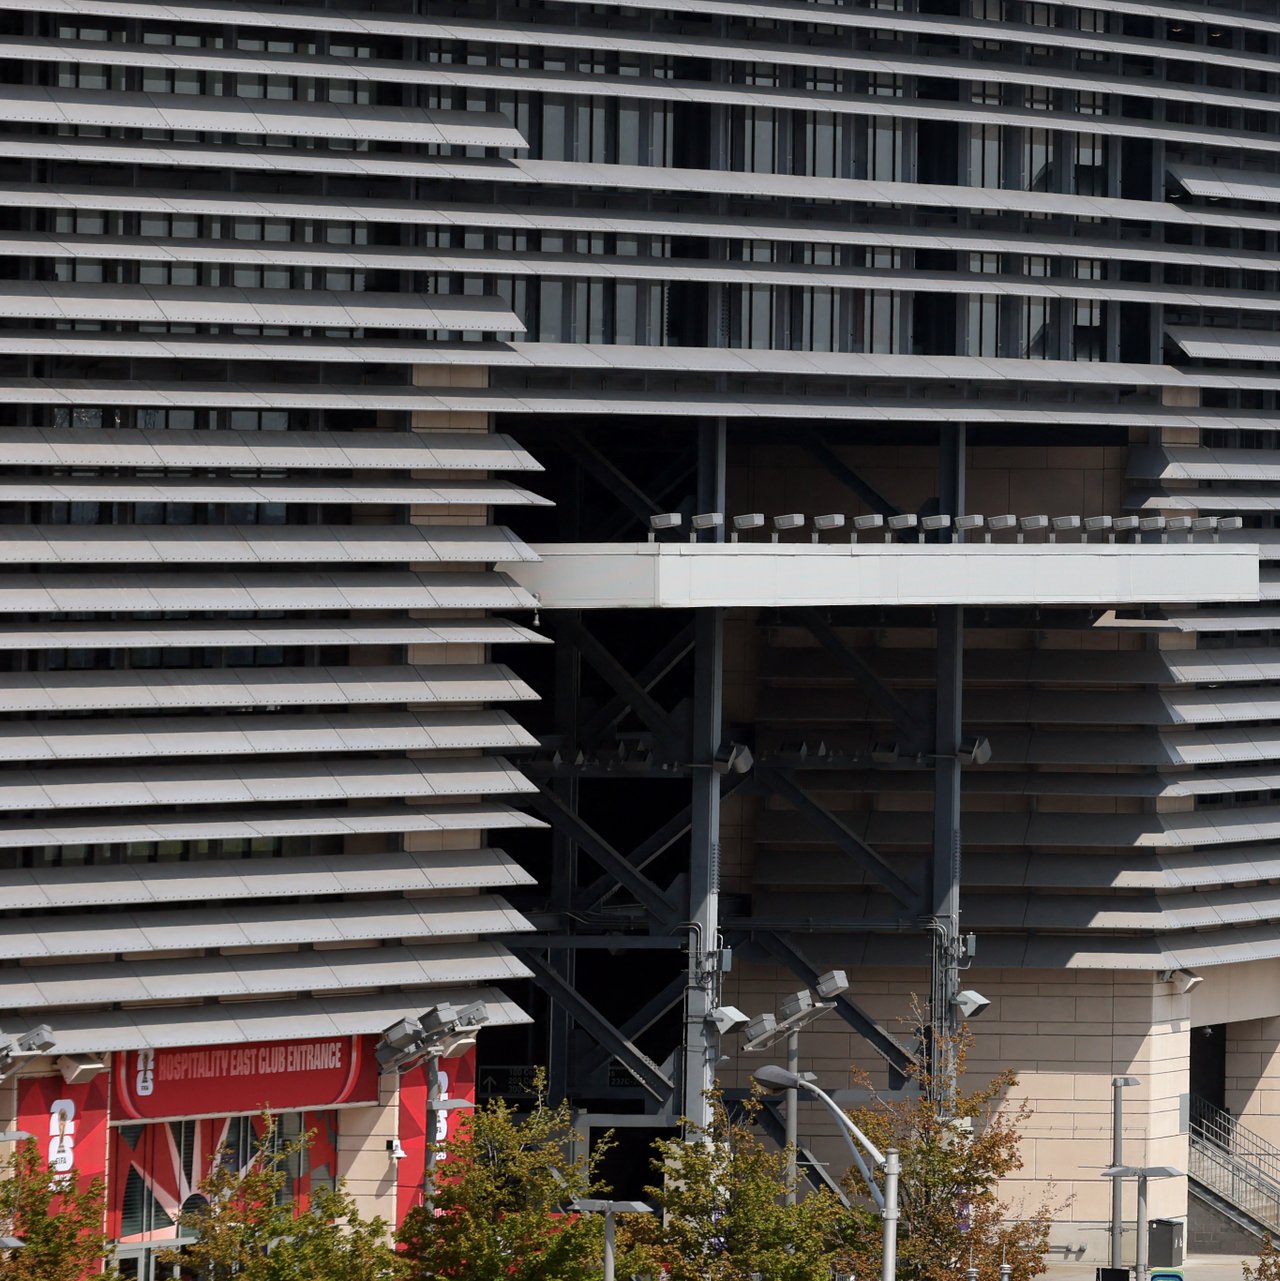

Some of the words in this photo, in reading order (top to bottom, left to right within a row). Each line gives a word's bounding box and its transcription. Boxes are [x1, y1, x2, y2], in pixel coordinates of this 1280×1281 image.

[159, 1050, 229, 1080] HOSPITALITY
[230, 1048, 257, 1076] EAST
[258, 1046, 286, 1074] CLUB
[287, 1043, 342, 1072] ENTRANCE
